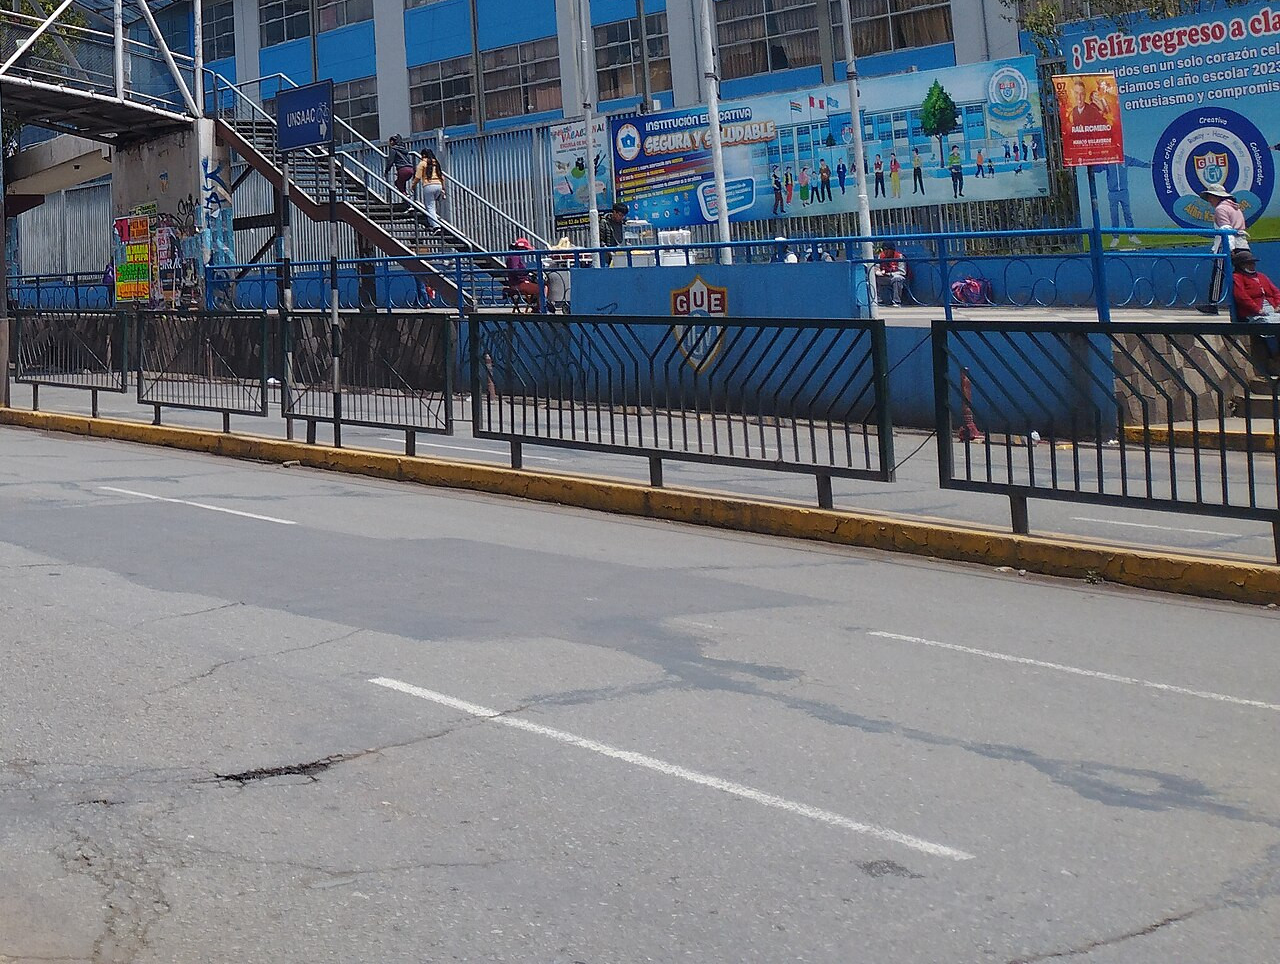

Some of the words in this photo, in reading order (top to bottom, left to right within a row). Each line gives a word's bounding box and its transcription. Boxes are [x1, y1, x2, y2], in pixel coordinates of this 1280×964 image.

[1140, 23, 1225, 55] regreso
[1230, 19, 1245, 37] a
[1143, 64, 1157, 74] en
[1159, 61, 1175, 72] un
[1177, 57, 1203, 69] solo
[1206, 46, 1257, 64] corazón
[1164, 76, 1174, 88] el
[1177, 72, 1199, 86] año
[1202, 66, 1249, 83] escolar
[1125, 93, 1195, 110] entusiasmo
[1197, 92, 1205, 105] y
[286, 108, 315, 127] UNSAAC
[700, 108, 752, 124] EDCATIVA
[1199, 117, 1227, 125] Creativo
[645, 133, 691, 152] SEGURA
[691, 130, 702, 148] Y
[705, 122, 775, 145] SLUDABLE
[1164, 138, 1177, 160] crítico
[1197, 156, 1225, 168] GUE
[1249, 141, 1264, 186] Colaborador
[676, 291, 722, 312] GUE
